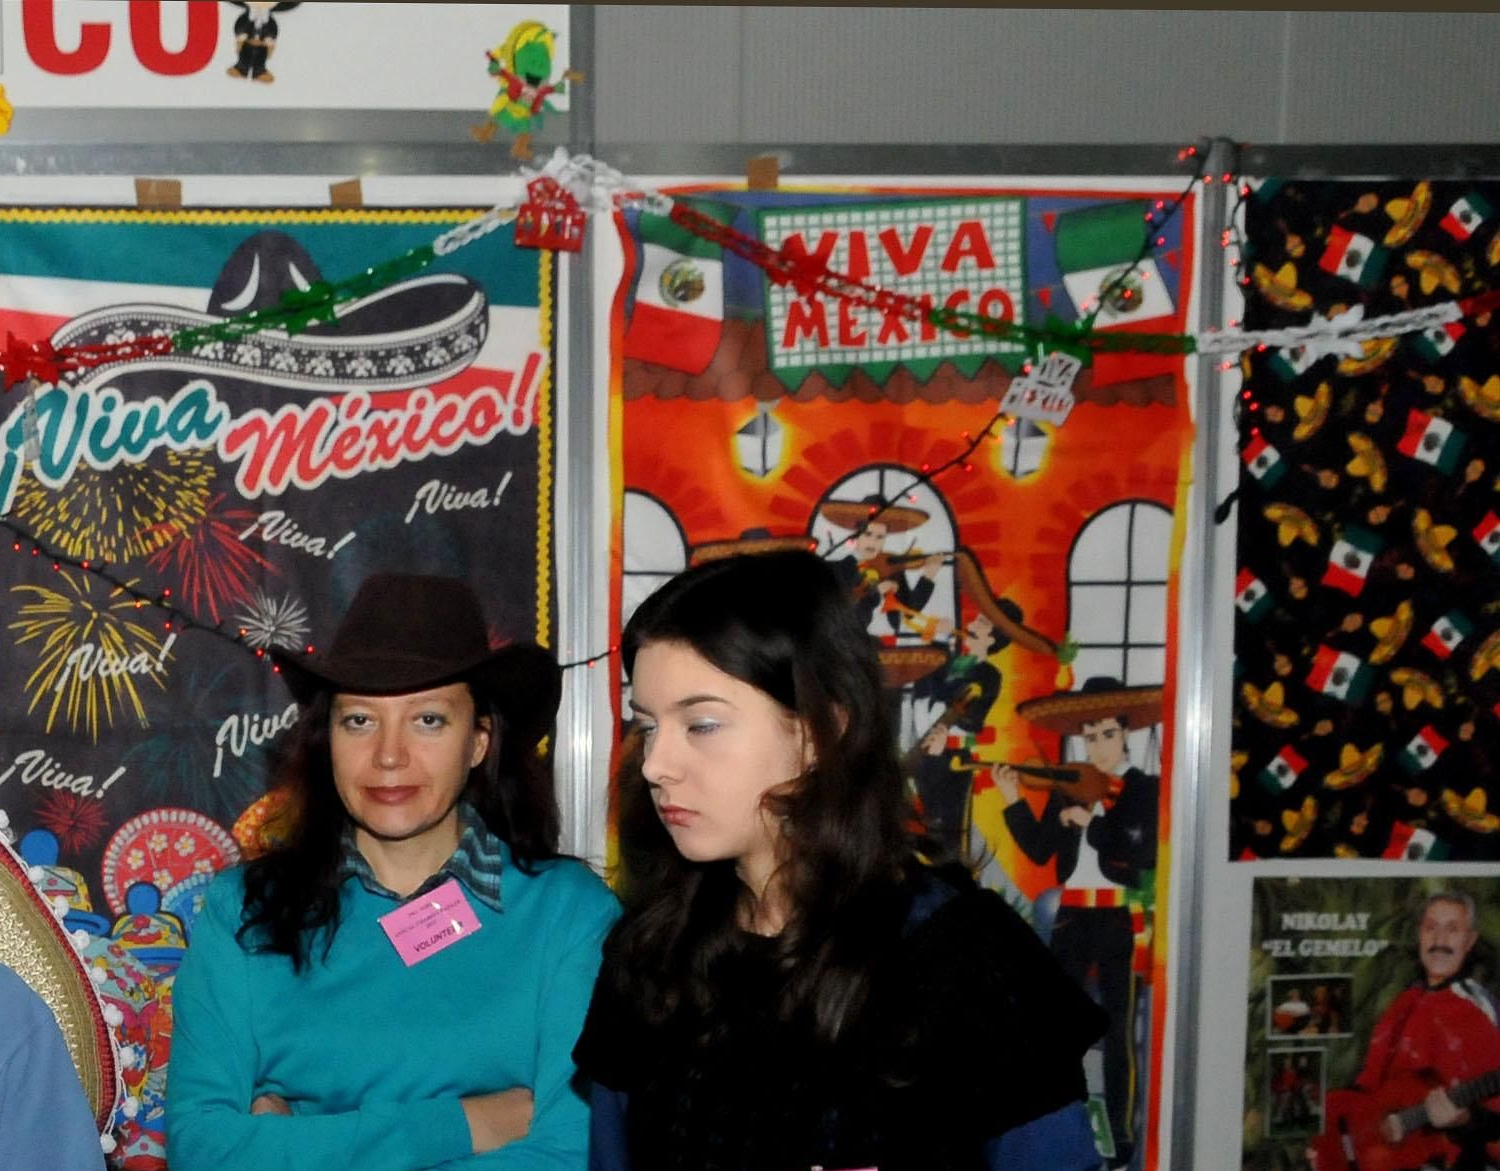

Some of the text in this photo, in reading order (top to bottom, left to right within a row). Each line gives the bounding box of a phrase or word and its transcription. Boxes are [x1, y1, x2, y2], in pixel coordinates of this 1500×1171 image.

[782, 220, 996, 285] VIVA
[782, 288, 1015, 348] MEXICO
[220, 353, 545, 498] México!
[405, 472, 513, 524] ¡Viva!
[239, 510, 356, 561] ¡Viva!
[54, 633, 177, 693] ¡Viva!
[413, 920, 464, 953] VOLUNTER
[1281, 912, 1371, 932] NIKOLAY
